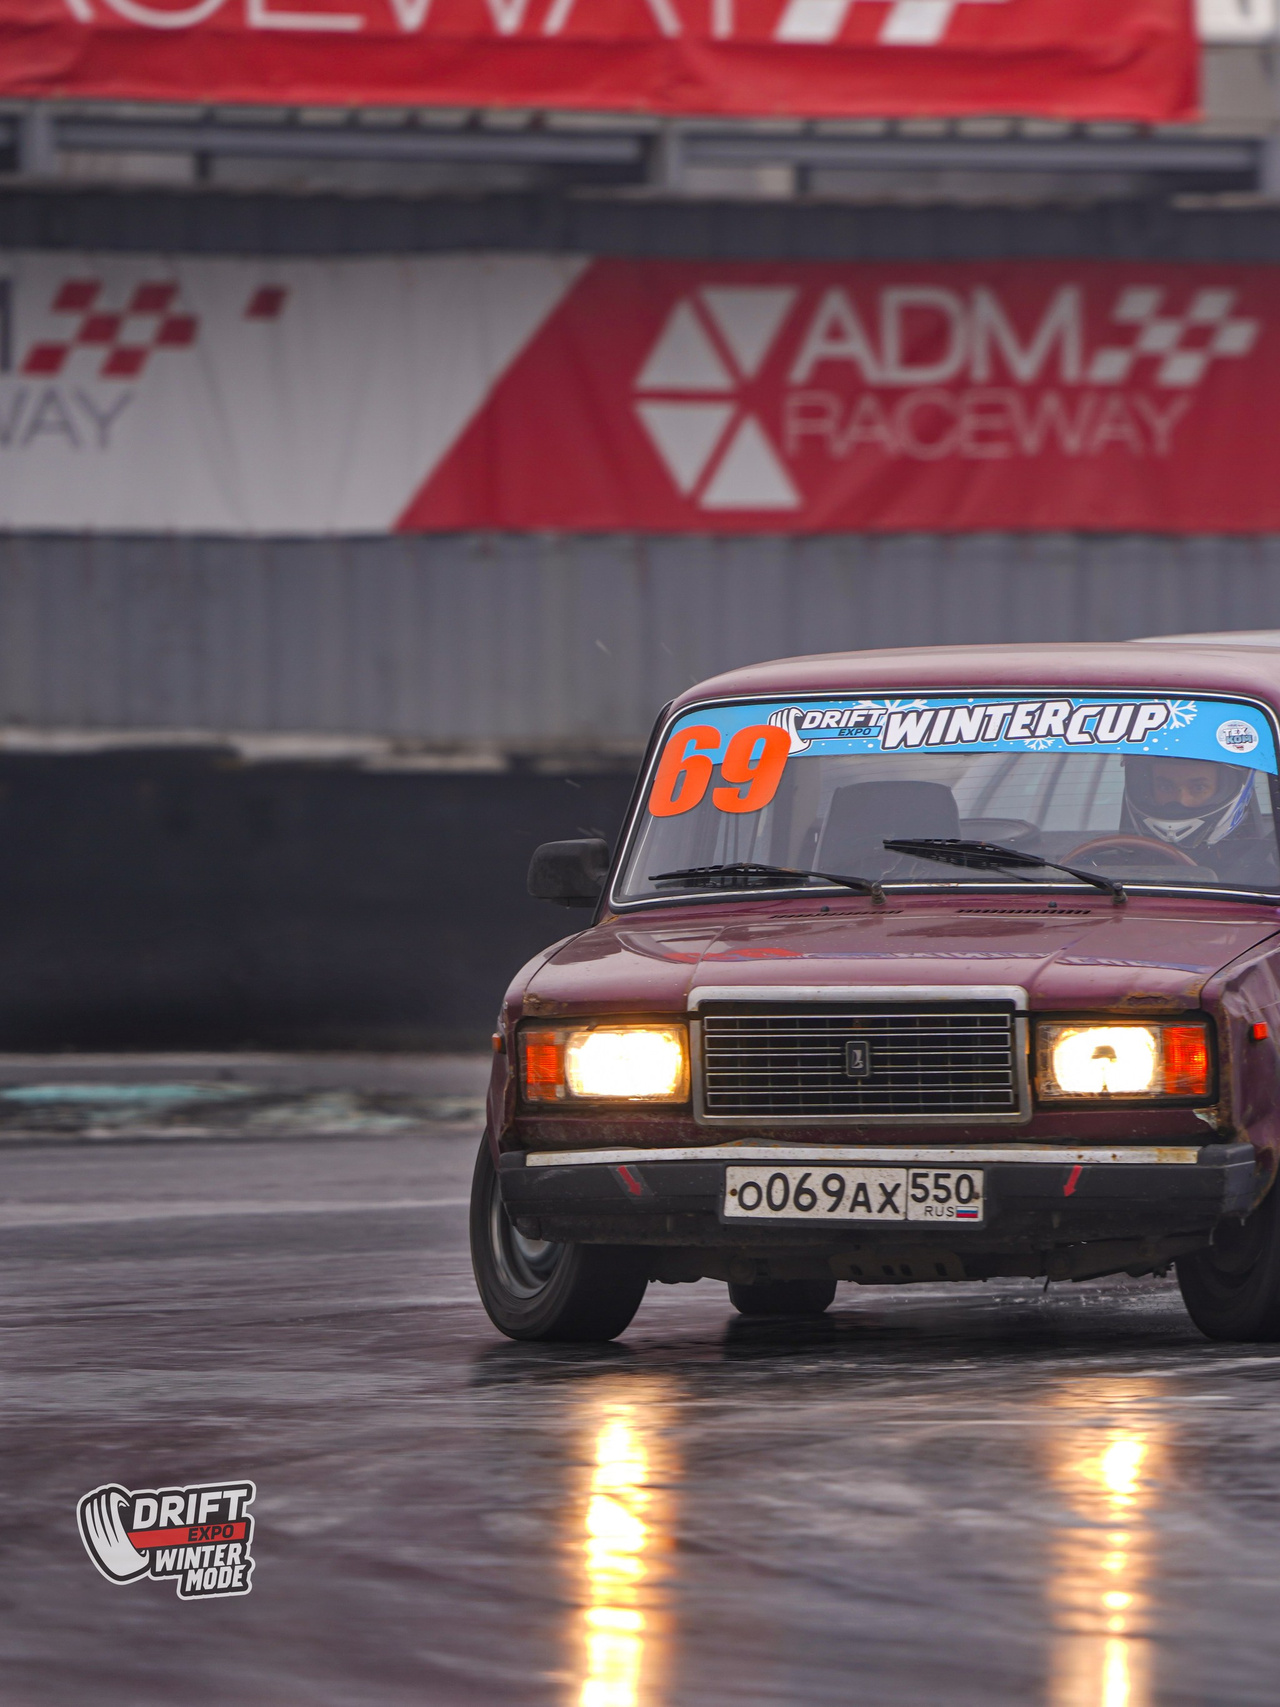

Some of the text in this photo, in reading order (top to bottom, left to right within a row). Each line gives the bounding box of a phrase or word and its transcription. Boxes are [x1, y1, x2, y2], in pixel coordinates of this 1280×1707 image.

[787, 285, 1081, 386] ADM
[783, 387, 1191, 460] RACEWAY
[801, 708, 888, 729] DRIFT
[838, 727, 872, 737] EXPO
[648, 724, 792, 817] 69
[910, 1172, 975, 1204] 550
[924, 1205, 955, 1218] RUS
